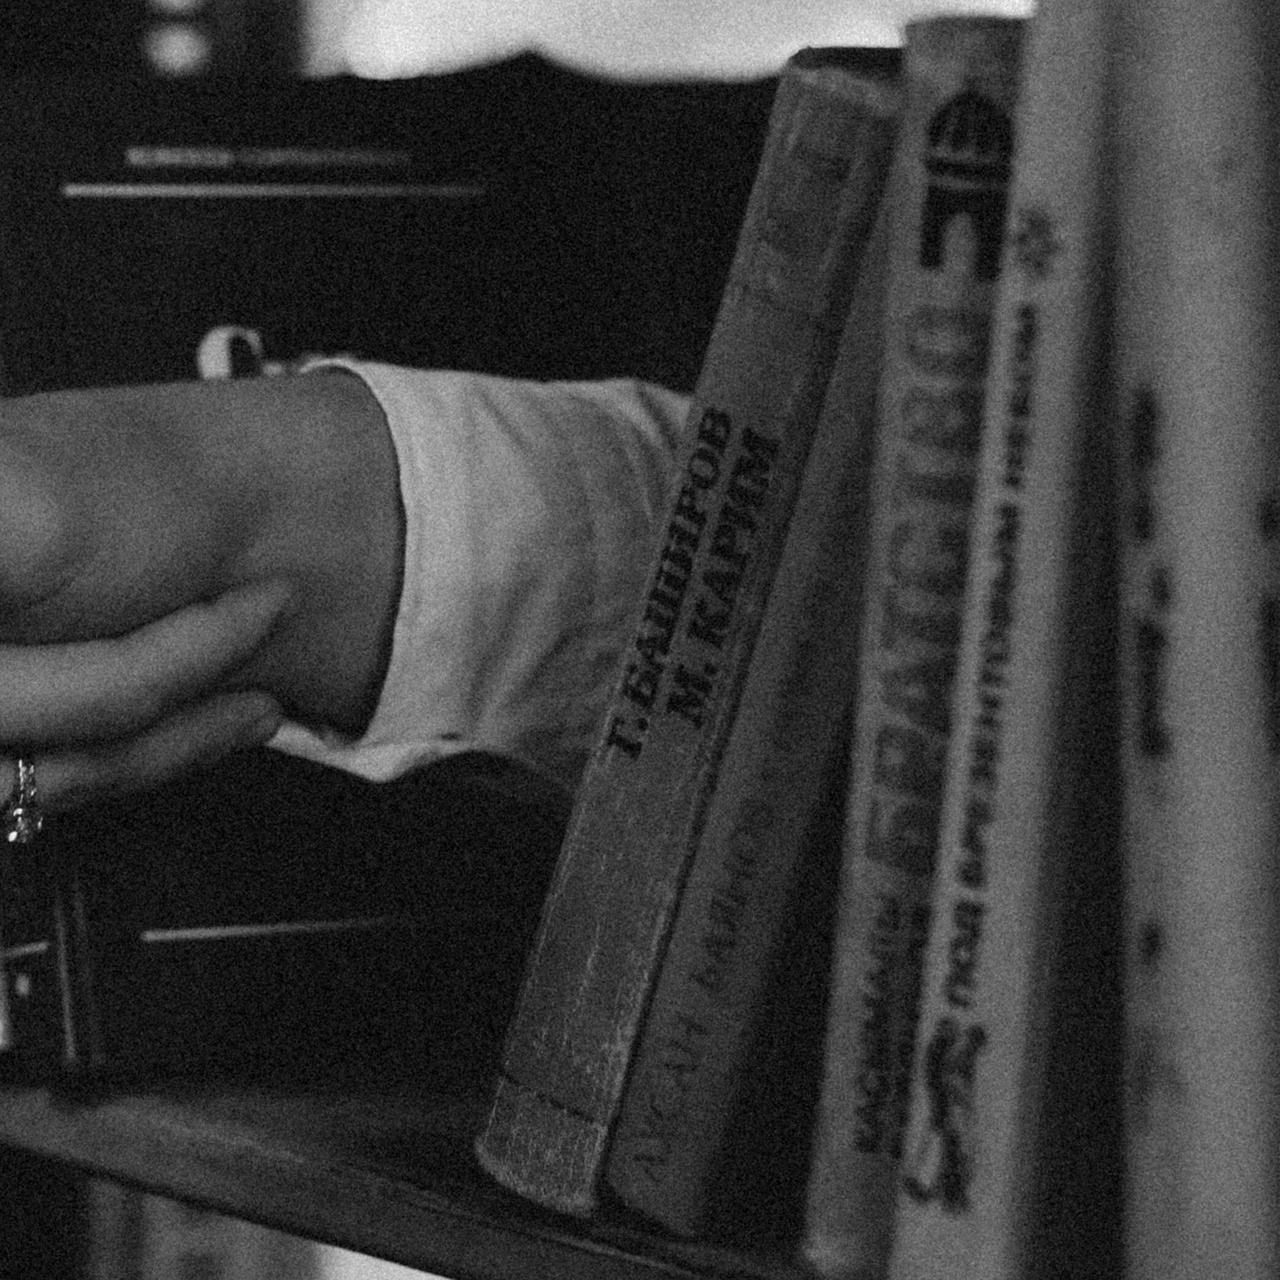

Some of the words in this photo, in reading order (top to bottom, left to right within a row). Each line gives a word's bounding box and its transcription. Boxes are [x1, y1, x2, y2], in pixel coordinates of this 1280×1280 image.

[623, 405, 734, 706] БАШИРОВ
[688, 428, 782, 646] КАРИМ
[867, 303, 991, 875] БРАТСТВО
[609, 704, 649, 759] Г.
[667, 655, 719, 730] М.
